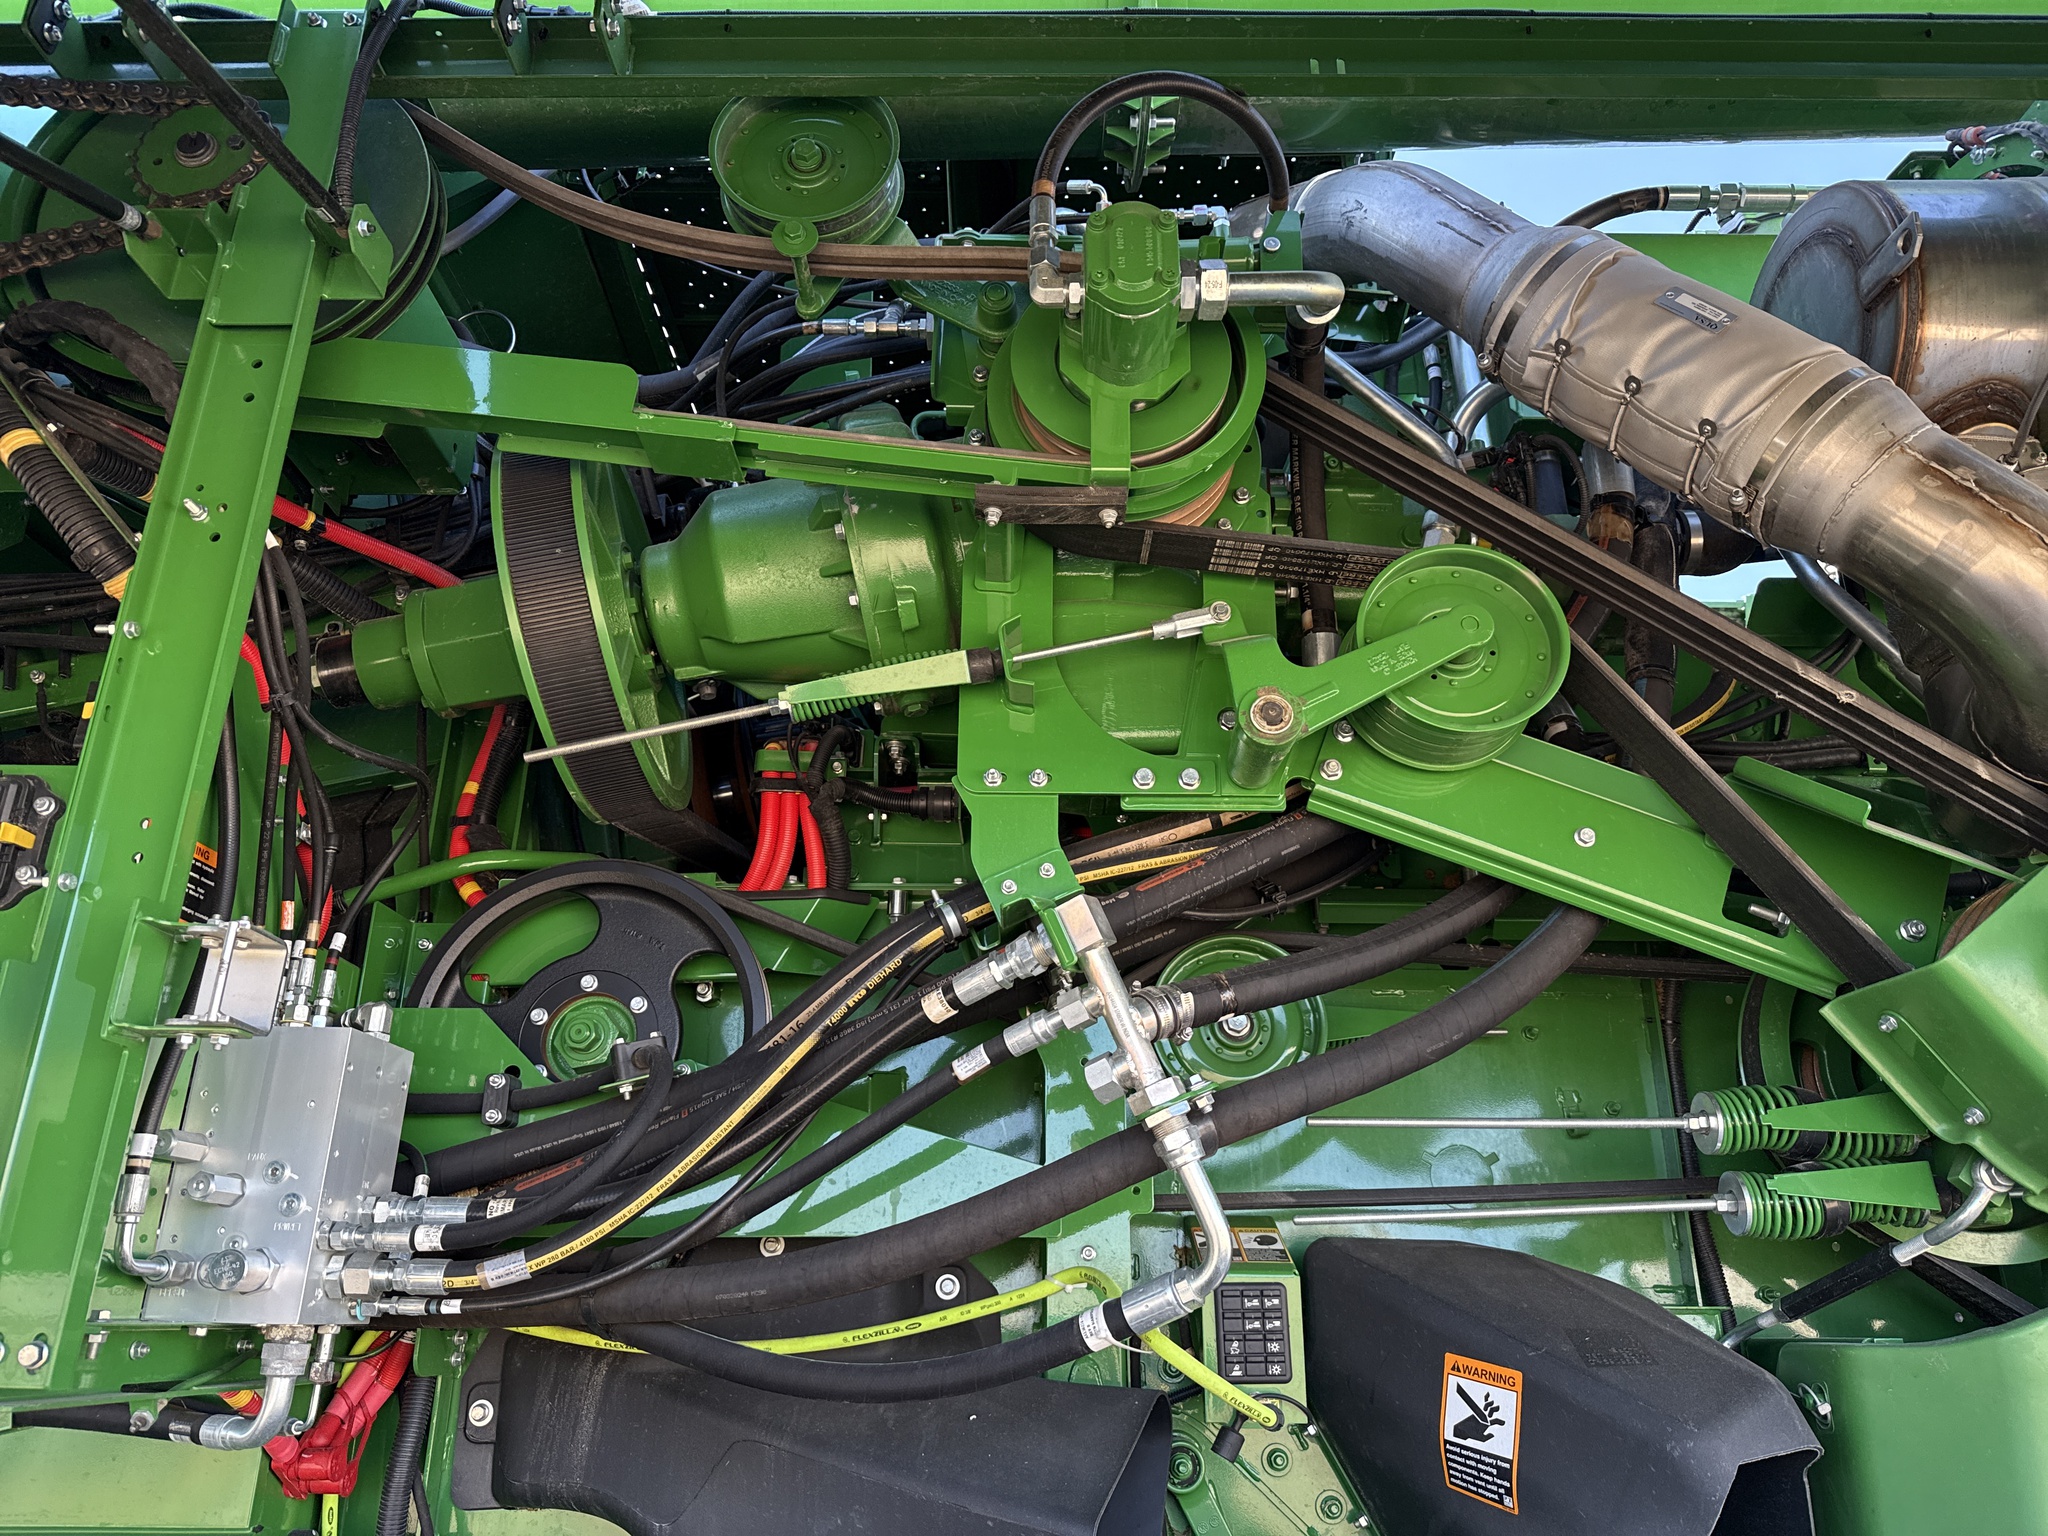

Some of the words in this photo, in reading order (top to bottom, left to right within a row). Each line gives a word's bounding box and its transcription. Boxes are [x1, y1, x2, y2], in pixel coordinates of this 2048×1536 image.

[1292, 447, 1301, 492] MARKWEL
[1292, 495, 1302, 514] SAE
[1137, 861, 1152, 870] FRAS
[827, 1005, 848, 1028] T4000
[868, 959, 902, 989] DIEHARD
[655, 1176, 673, 1193] FRAS
[676, 1146, 706, 1175] ABRASION
[704, 1119, 735, 1149] RESISTANT
[534, 1258, 546, 1268] WP
[546, 1252, 559, 1263] 280
[559, 1244, 575, 1257] BAR
[578, 1234, 594, 1247] 4100
[593, 1227, 606, 1238] PSI
[608, 1212, 628, 1228] MSHA
[625, 1192, 655, 1215] IC-227/12
[852, 1325, 900, 1344] FLEXZILLA
[1462, 1363, 1516, 1388] WARNING
[1446, 1444, 1460, 1452] Avoid
[1461, 1450, 1480, 1459] serious
[1481, 1455, 1496, 1465] injury
[1497, 1460, 1510, 1469] from
[1447, 1453, 1465, 1463] contact
[1478, 1464, 1497, 1475] moving
[1448, 1461, 1479, 1476] components.
[1480, 1472, 1493, 1482] Keep
[1494, 1477, 1510, 1487] hands
[1450, 1470, 1461, 1478] away
[1462, 1474, 1474, 1482] from
[1475, 1479, 1486, 1487] vent
[1486, 1483, 1498, 1491] until
[1451, 1478, 1468, 1487] motion
[1468, 1483, 1477, 1491] has
[1478, 1488, 1500, 1500] stopped.
